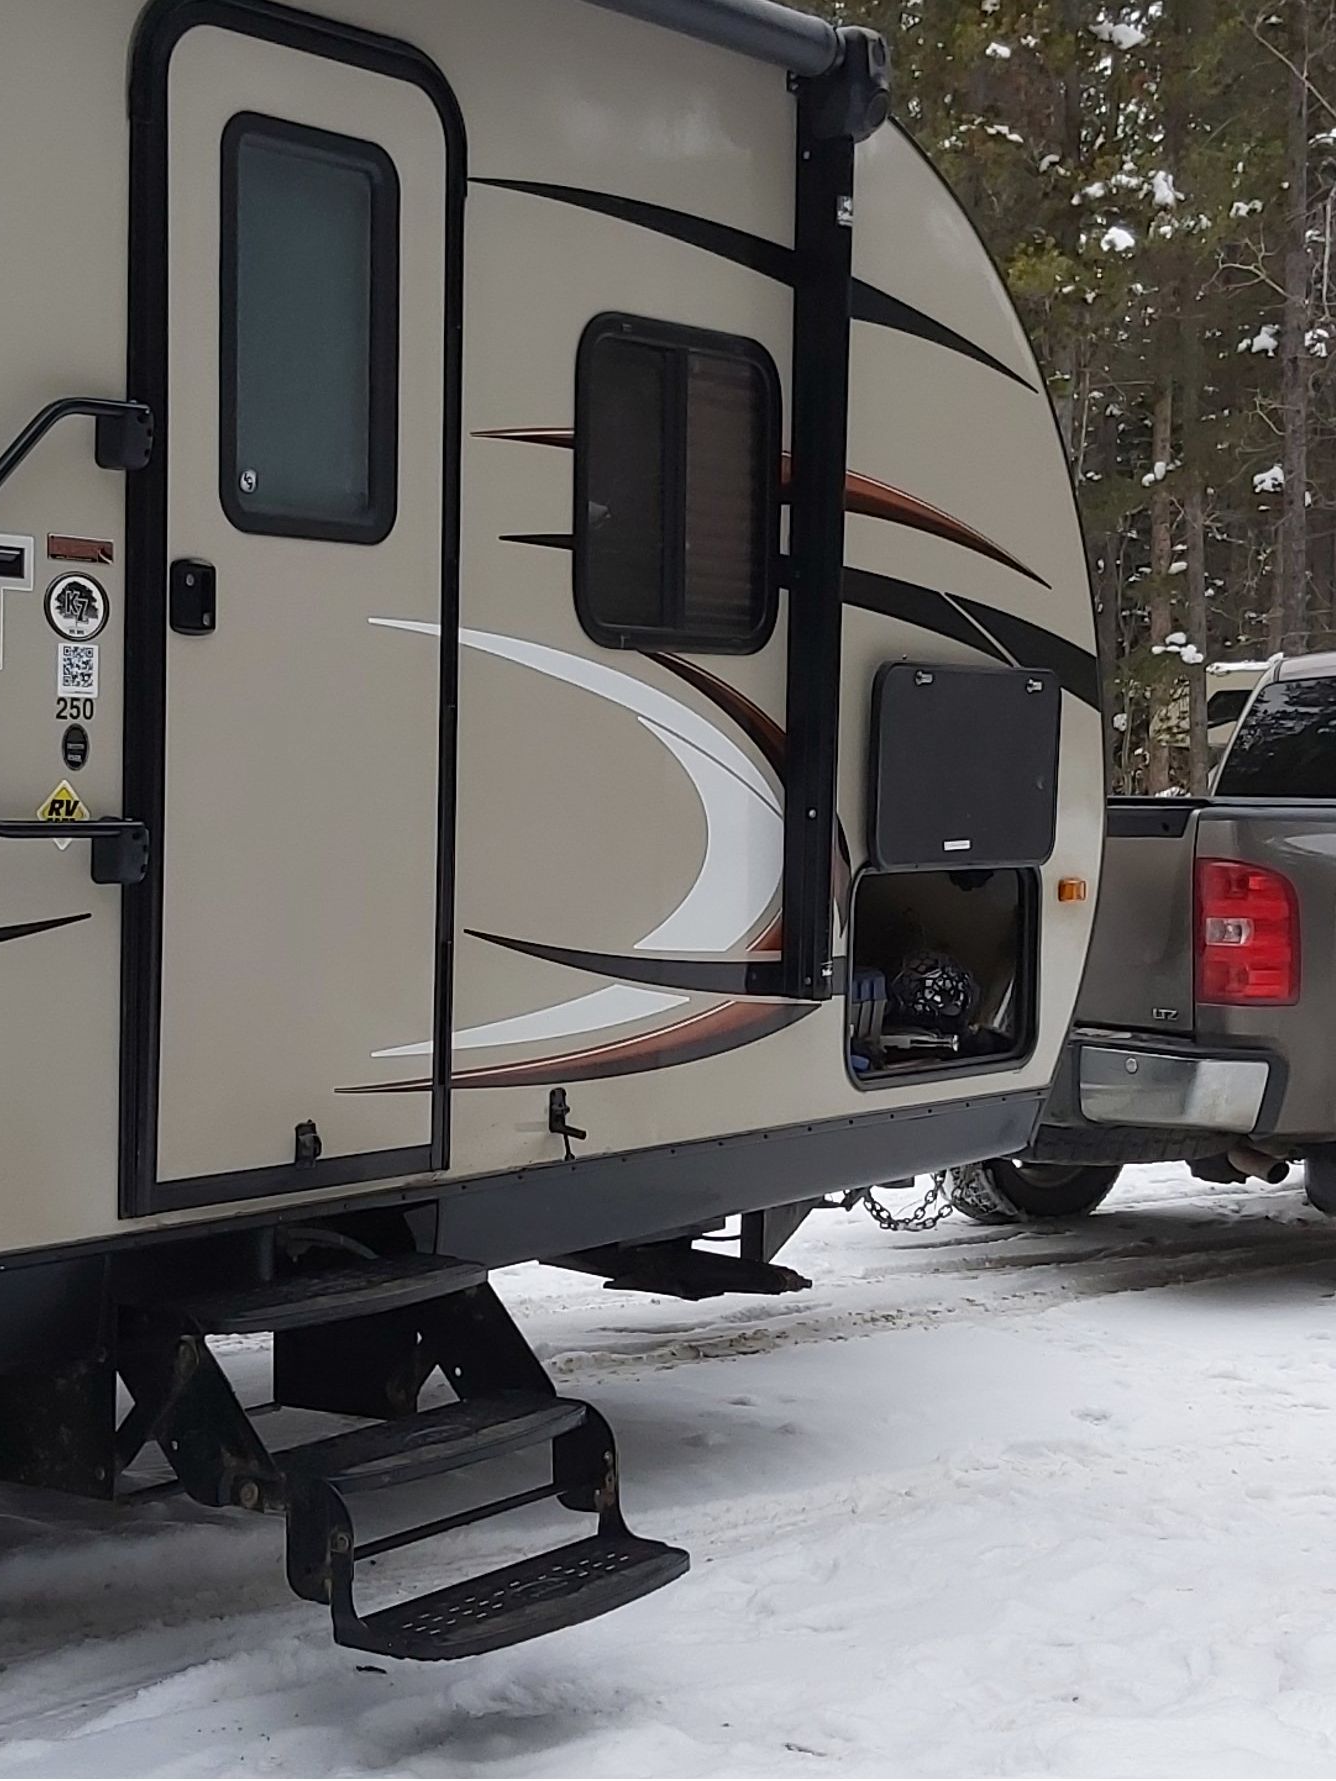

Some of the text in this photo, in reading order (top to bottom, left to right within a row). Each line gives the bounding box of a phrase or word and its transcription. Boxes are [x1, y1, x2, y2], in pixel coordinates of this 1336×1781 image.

[55, 697, 94, 720] 250
[47, 799, 80, 817] RV
[1152, 1007, 1178, 1021] LTZ
